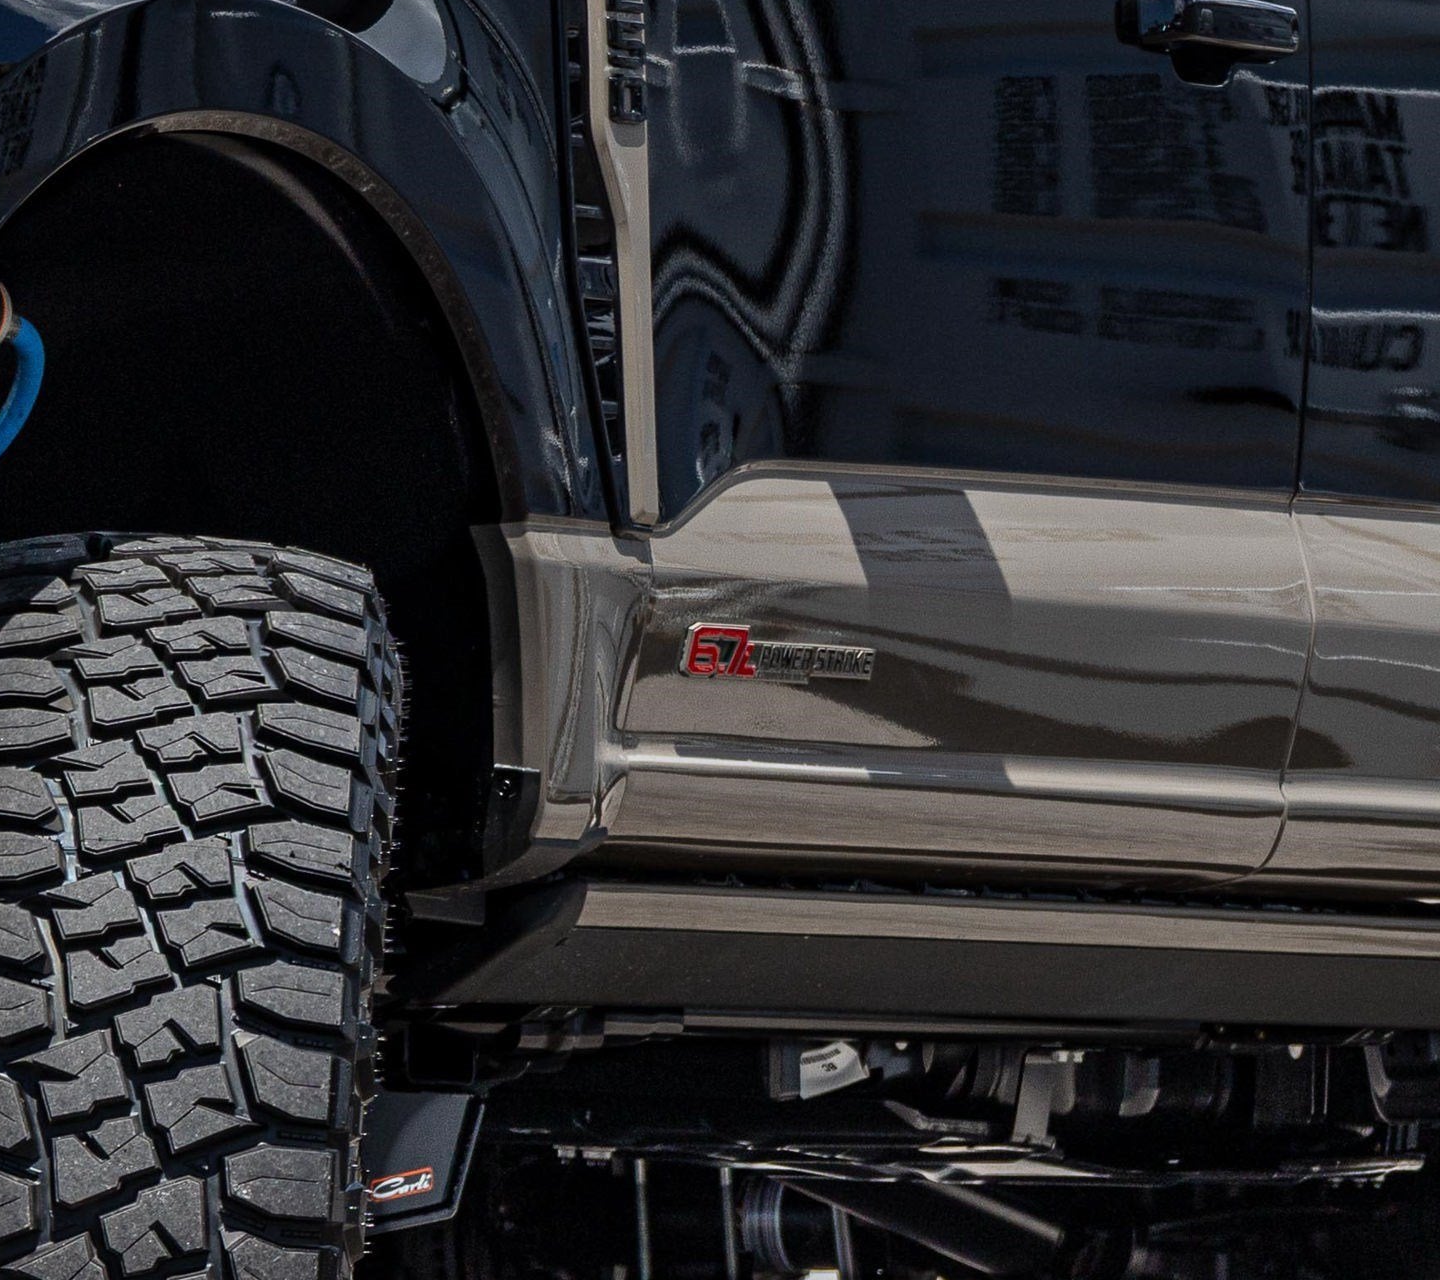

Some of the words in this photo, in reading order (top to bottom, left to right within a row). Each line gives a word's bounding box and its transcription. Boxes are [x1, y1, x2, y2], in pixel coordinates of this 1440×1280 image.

[761, 644, 813, 671] POWER
[813, 648, 874, 674] STROKE
[372, 1173, 432, 1199] Carli
